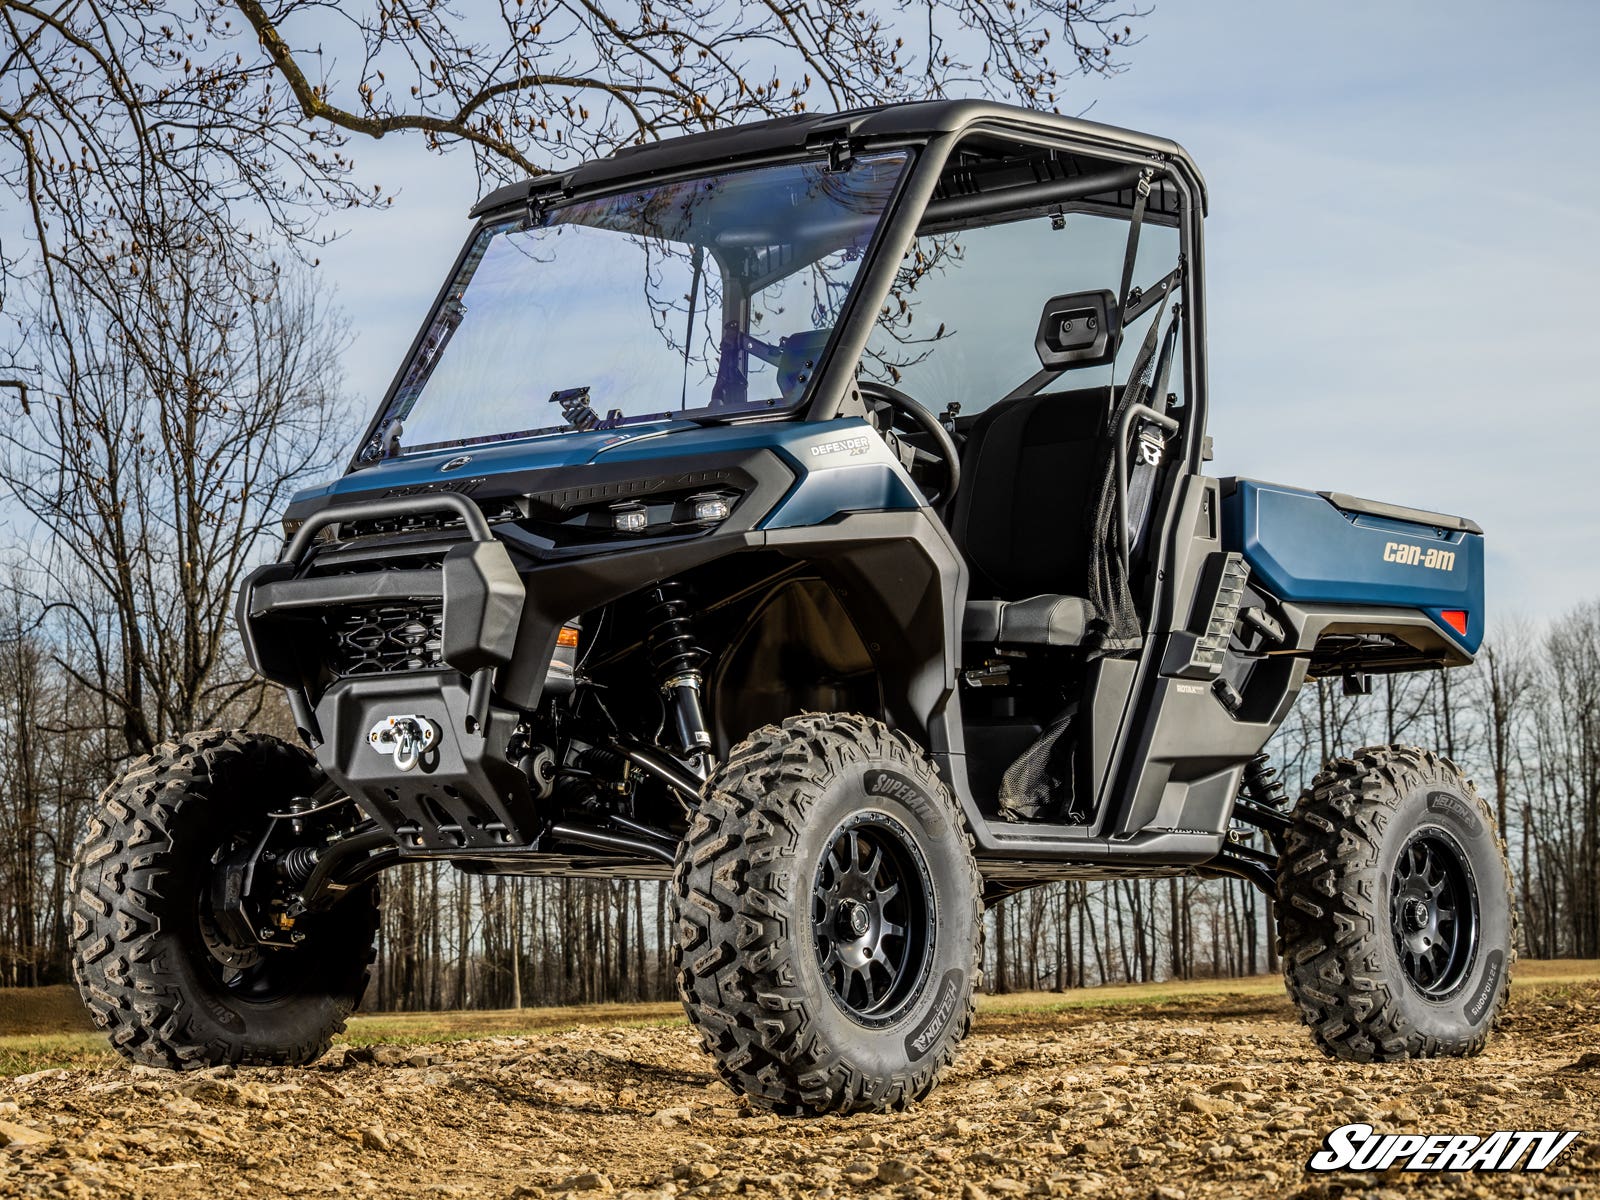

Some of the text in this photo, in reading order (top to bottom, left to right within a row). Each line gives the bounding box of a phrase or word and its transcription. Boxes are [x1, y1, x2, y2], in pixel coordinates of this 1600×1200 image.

[811, 436, 869, 456] DEFENDER
[1383, 542, 1455, 571] can-am
[923, 978, 958, 1044] HELLION
